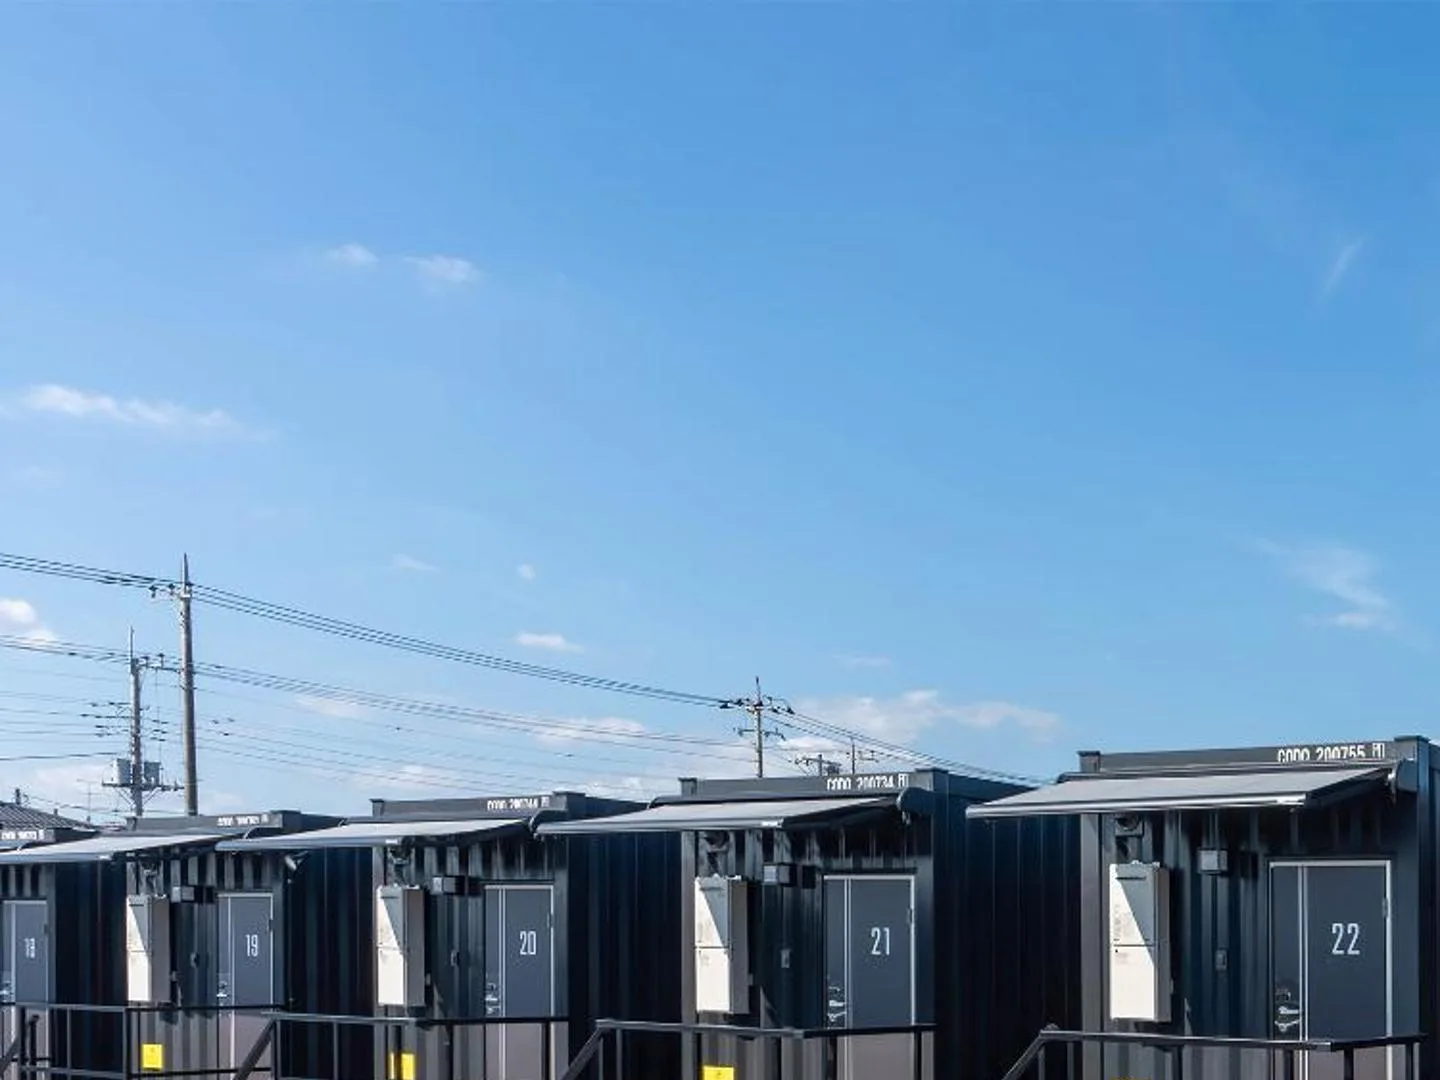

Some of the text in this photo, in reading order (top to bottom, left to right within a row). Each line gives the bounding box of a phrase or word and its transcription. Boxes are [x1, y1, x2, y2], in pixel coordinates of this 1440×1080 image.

[245, 933, 259, 957] 19
[519, 930, 537, 955] 20
[871, 927, 890, 955] 21
[1331, 923, 1360, 955] 22
